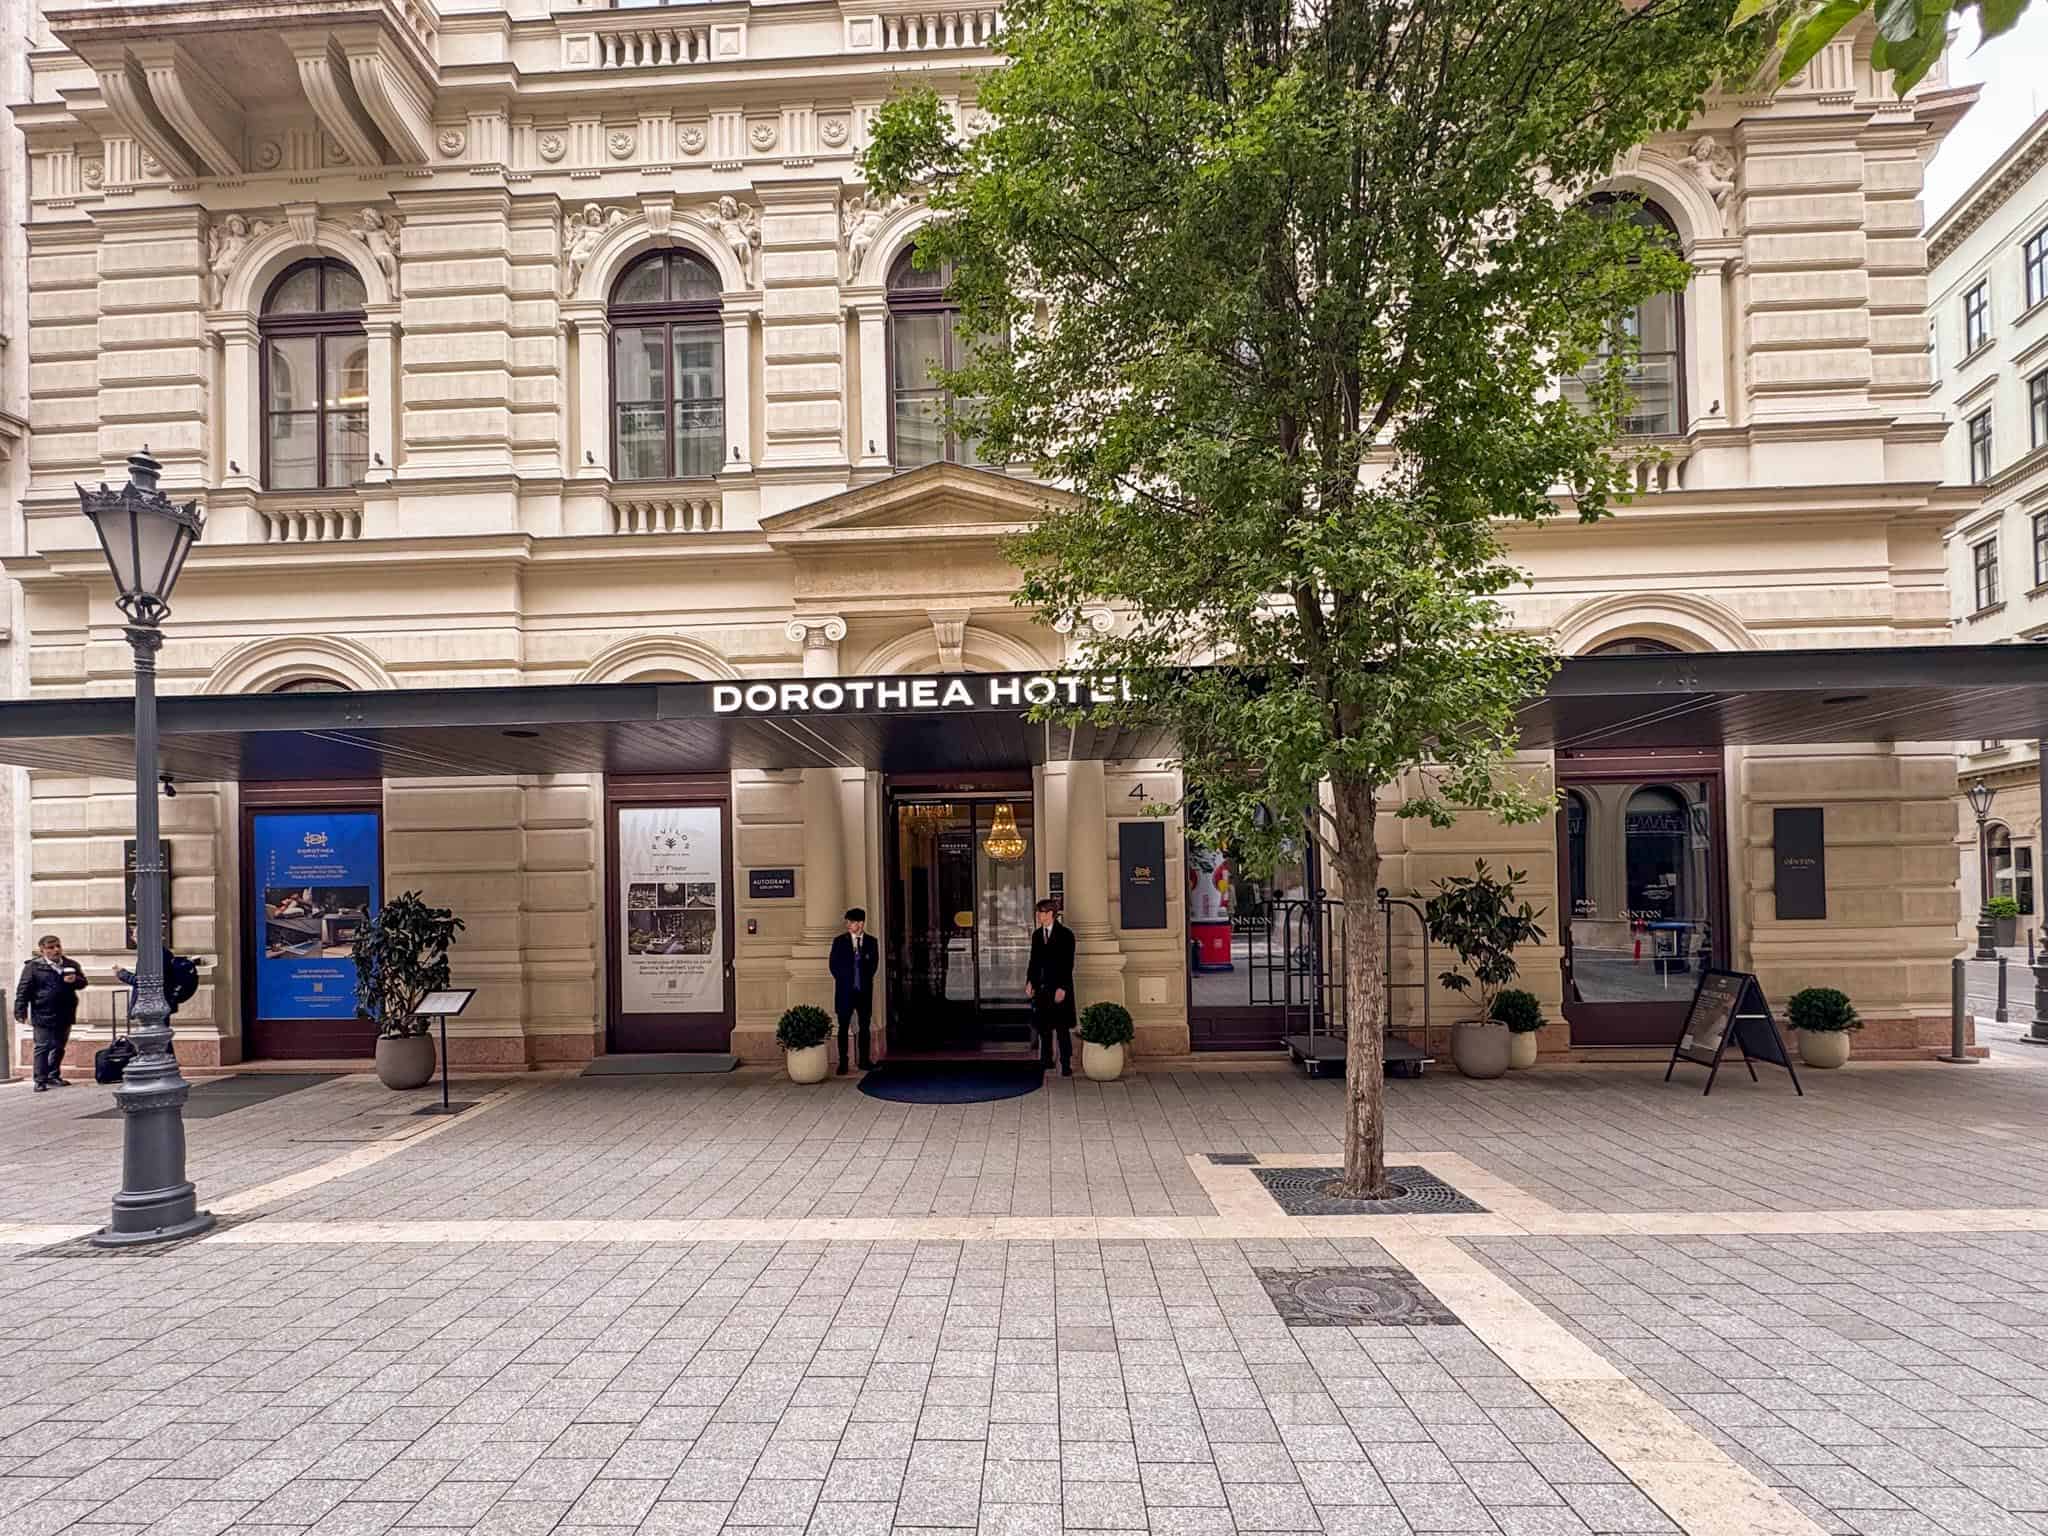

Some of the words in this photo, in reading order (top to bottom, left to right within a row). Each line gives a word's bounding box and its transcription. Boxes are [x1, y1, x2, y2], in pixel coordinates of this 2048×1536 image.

[713, 679, 973, 713] DOROTHEA
[990, 675, 1147, 705] HOTEL
[1128, 783, 1154, 801] 4.
